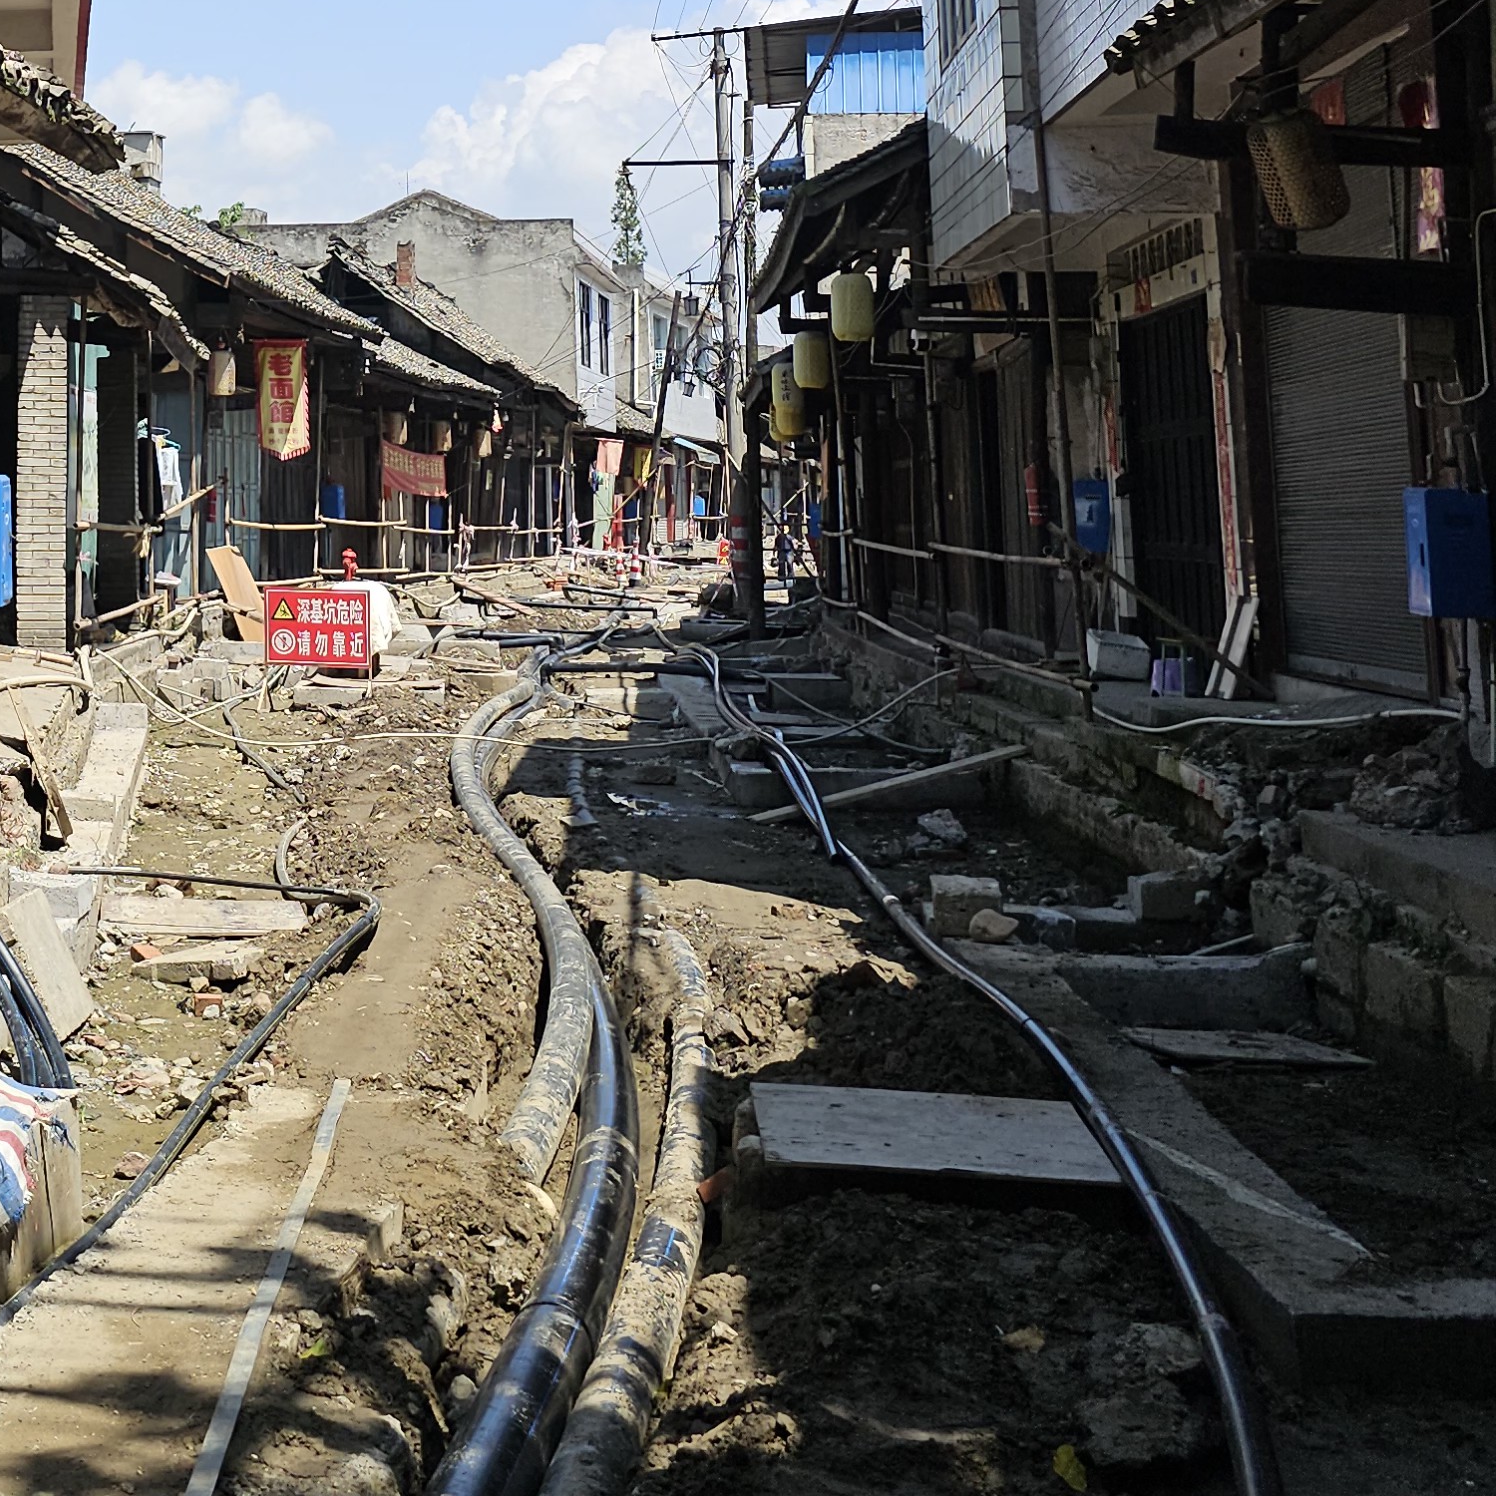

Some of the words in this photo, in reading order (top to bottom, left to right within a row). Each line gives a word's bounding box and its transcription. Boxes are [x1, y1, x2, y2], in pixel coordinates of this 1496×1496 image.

[296, 598, 364, 625] 深基坑危险
[297, 630, 364, 658] 请勿靠近
